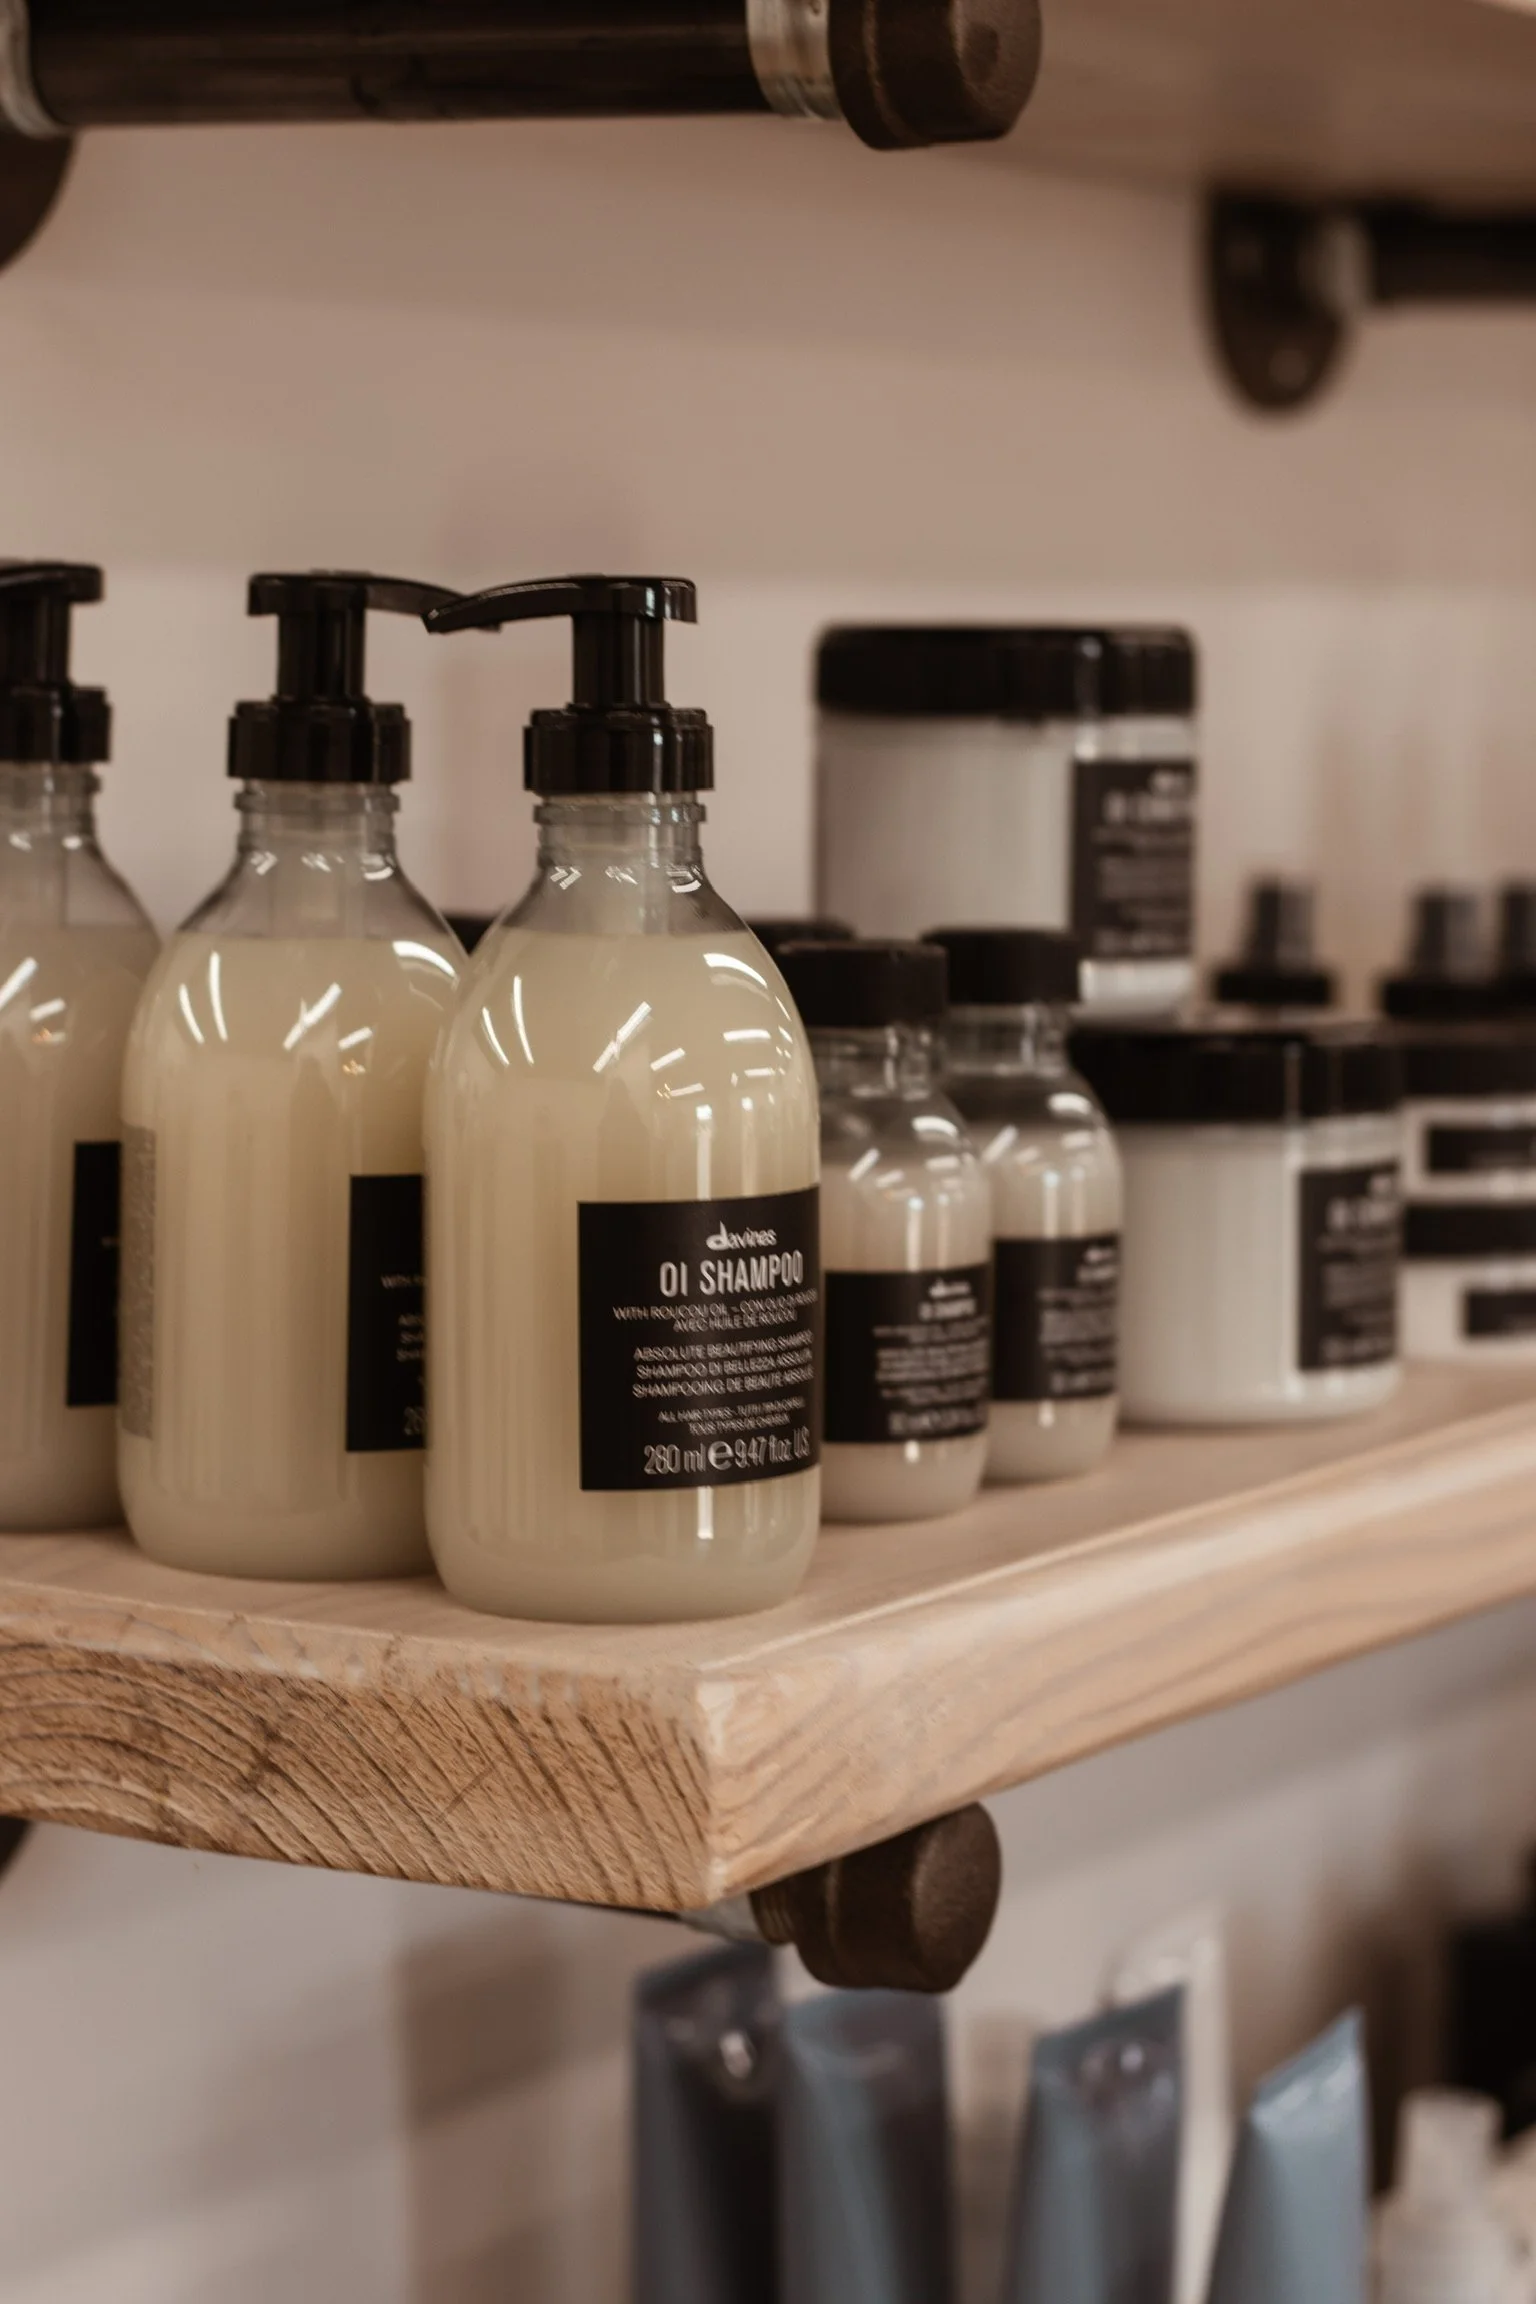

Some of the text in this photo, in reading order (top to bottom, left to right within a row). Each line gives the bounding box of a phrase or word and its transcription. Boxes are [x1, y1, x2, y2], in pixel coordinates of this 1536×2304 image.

[706, 1220, 777, 1250] davines
[660, 1250, 803, 1297] OI SHAMPOO
[612, 1305, 649, 1320] WITH
[633, 1345, 706, 1361] ABSOLUTE
[636, 1362, 708, 1379] SHAMPOO
[632, 1379, 725, 1398] SHAMPOOING
[643, 1444, 681, 1475] 280
[683, 1443, 706, 1473] ml
